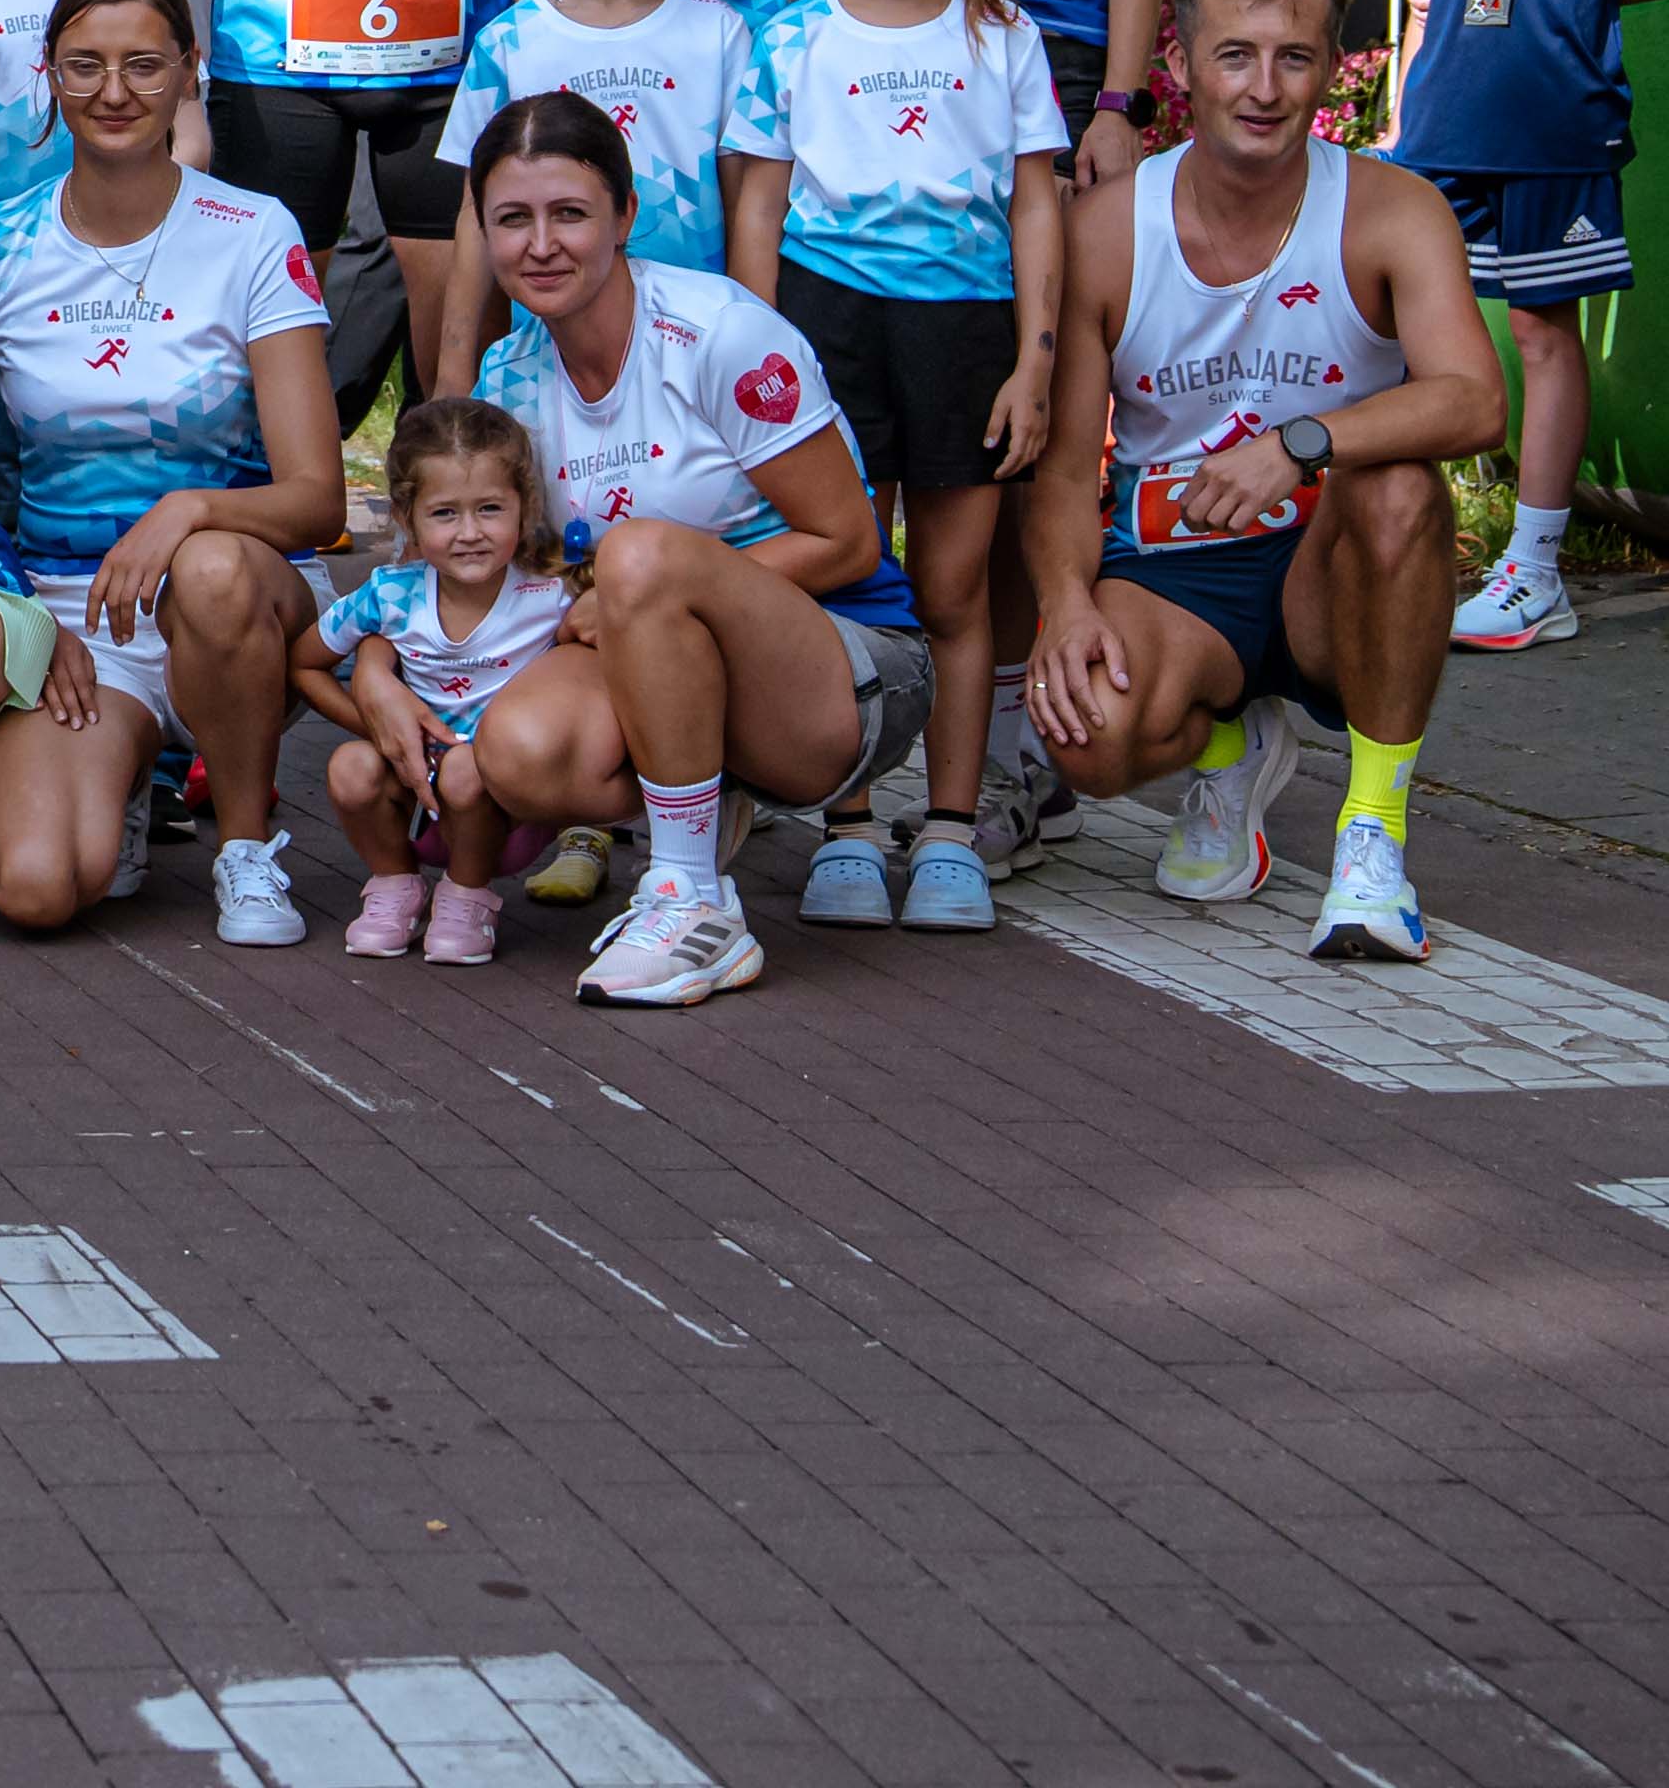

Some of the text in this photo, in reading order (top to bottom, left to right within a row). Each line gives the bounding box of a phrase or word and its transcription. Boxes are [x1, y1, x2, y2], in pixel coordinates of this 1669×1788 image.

[859, 69, 953, 94] BIEGAJĄCE
[755, 372, 785, 402] RUN
[1157, 348, 1321, 398] BIEGAJĄCE
